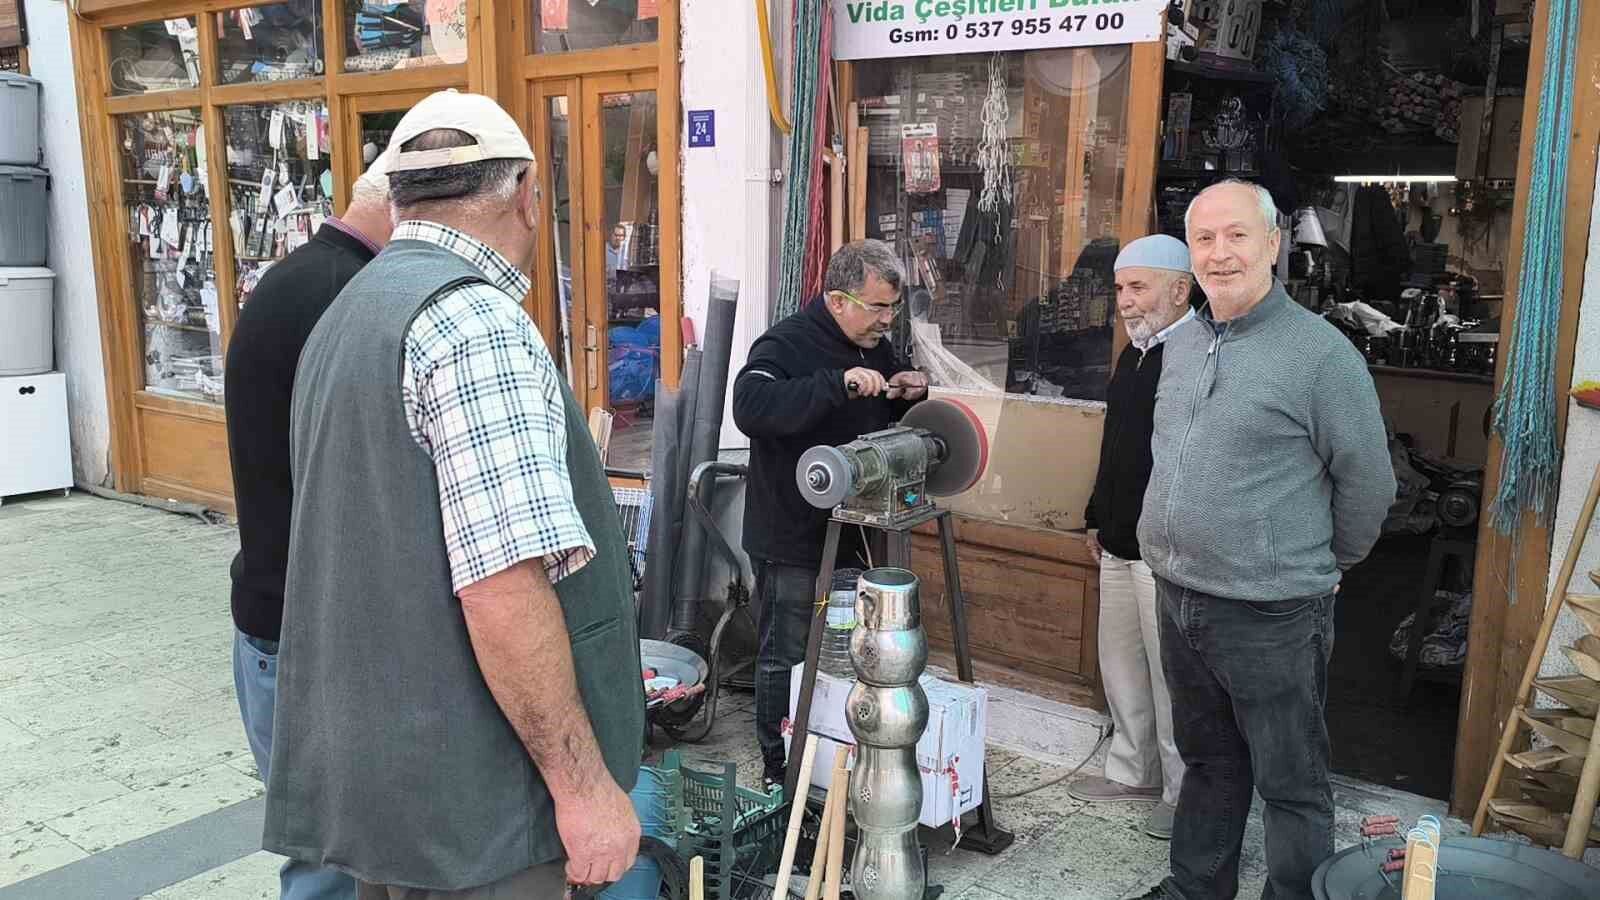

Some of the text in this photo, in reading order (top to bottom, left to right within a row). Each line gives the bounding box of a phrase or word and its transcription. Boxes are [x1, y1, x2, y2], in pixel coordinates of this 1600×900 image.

[847, 1, 905, 23] Vida
[889, 12, 1124, 43] Gsm: 0 537 955 47 00
[695, 122, 706, 135] 24
